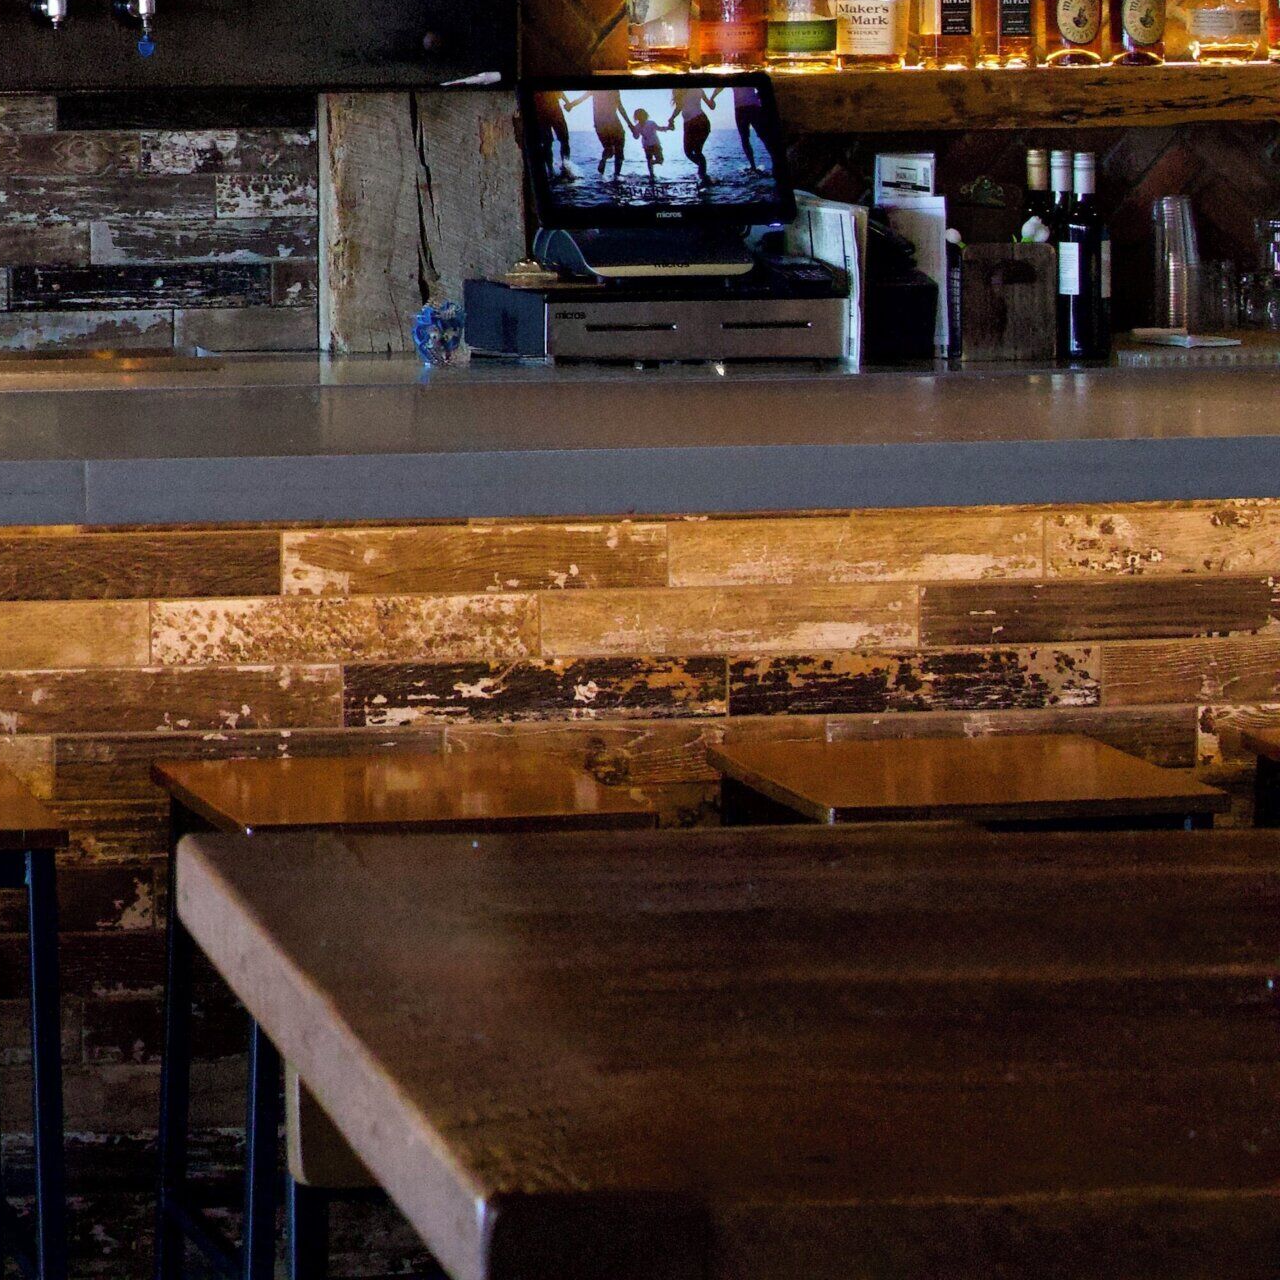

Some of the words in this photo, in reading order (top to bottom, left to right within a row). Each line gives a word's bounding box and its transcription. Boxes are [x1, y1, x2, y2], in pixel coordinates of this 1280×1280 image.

[838, 3, 889, 13] Maker's
[851, 15, 889, 25] Mark
[656, 210, 683, 219] micros
[555, 311, 587, 320] micros
